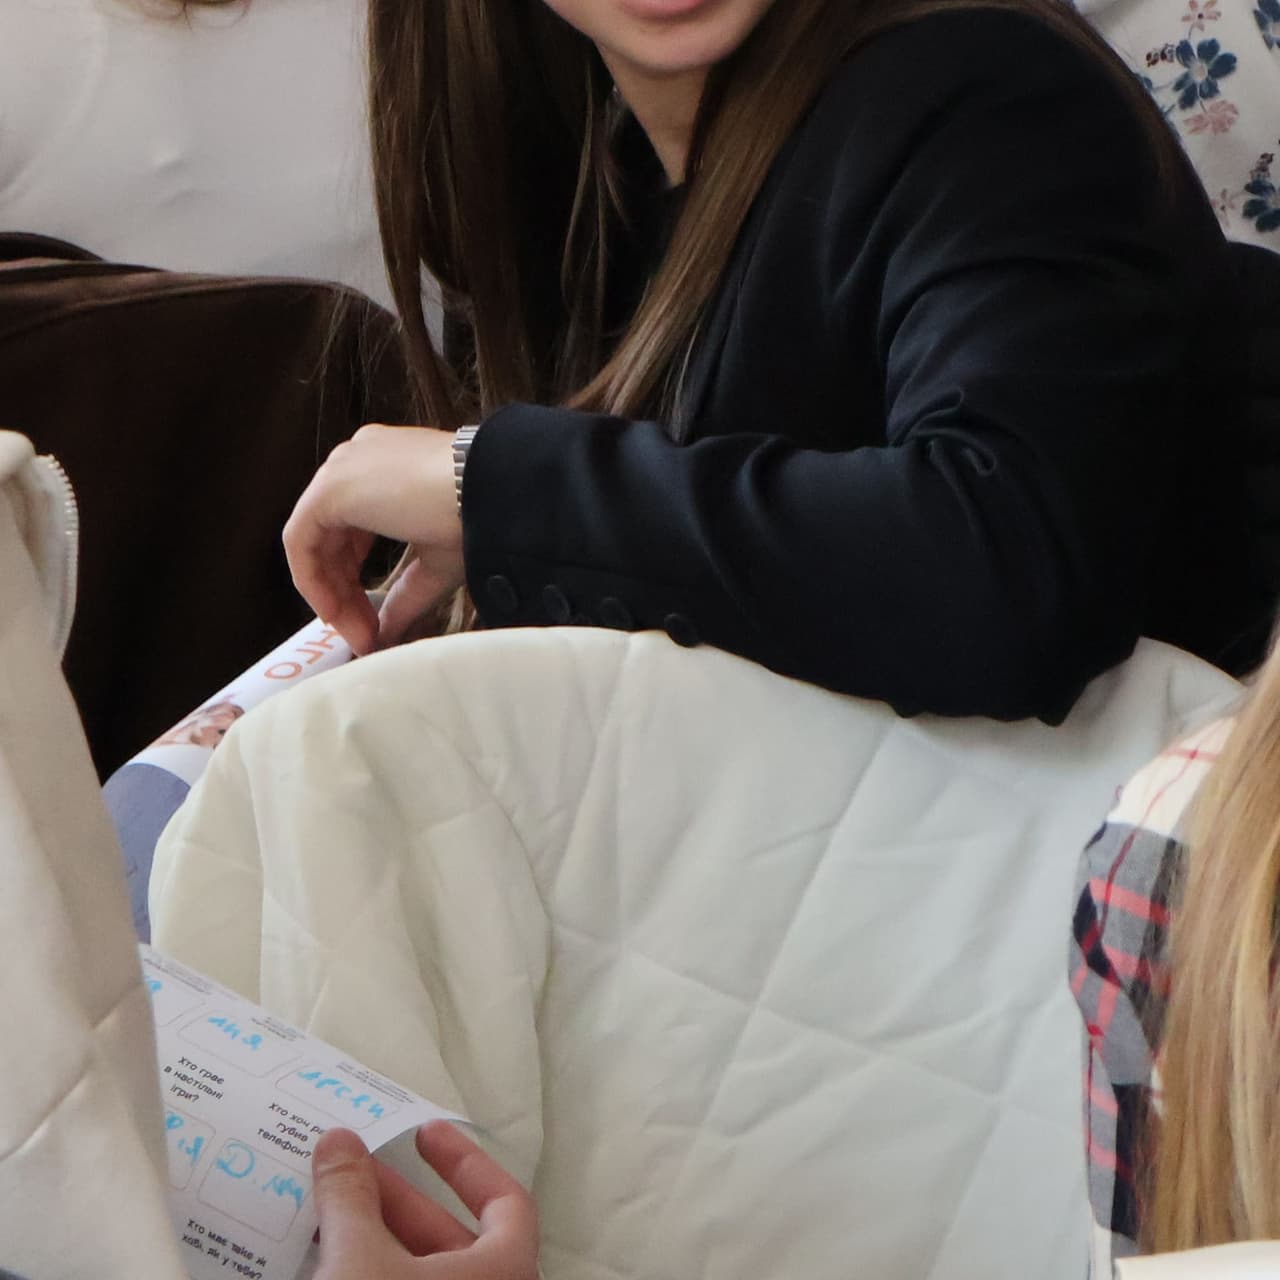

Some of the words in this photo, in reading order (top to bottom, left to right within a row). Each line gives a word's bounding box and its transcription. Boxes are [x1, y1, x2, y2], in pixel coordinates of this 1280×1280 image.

[263, 628, 339, 679] НГО
[163, 1065, 172, 1073] в
[173, 1070, 224, 1100] настільні
[178, 1056, 198, 1071] Хто
[199, 1066, 225, 1085] грає
[170, 1084, 200, 1103] ігри?
[269, 1102, 288, 1117] Хто
[289, 1114, 310, 1128] хоч
[257, 1127, 312, 1160] телефон?
[276, 1122, 309, 1143] губив
[187, 1219, 205, 1234] Хто
[230, 1243, 254, 1261] таке
[207, 1247, 220, 1260] як
[222, 1256, 230, 1266] у
[232, 1260, 263, 1280] тебе?
